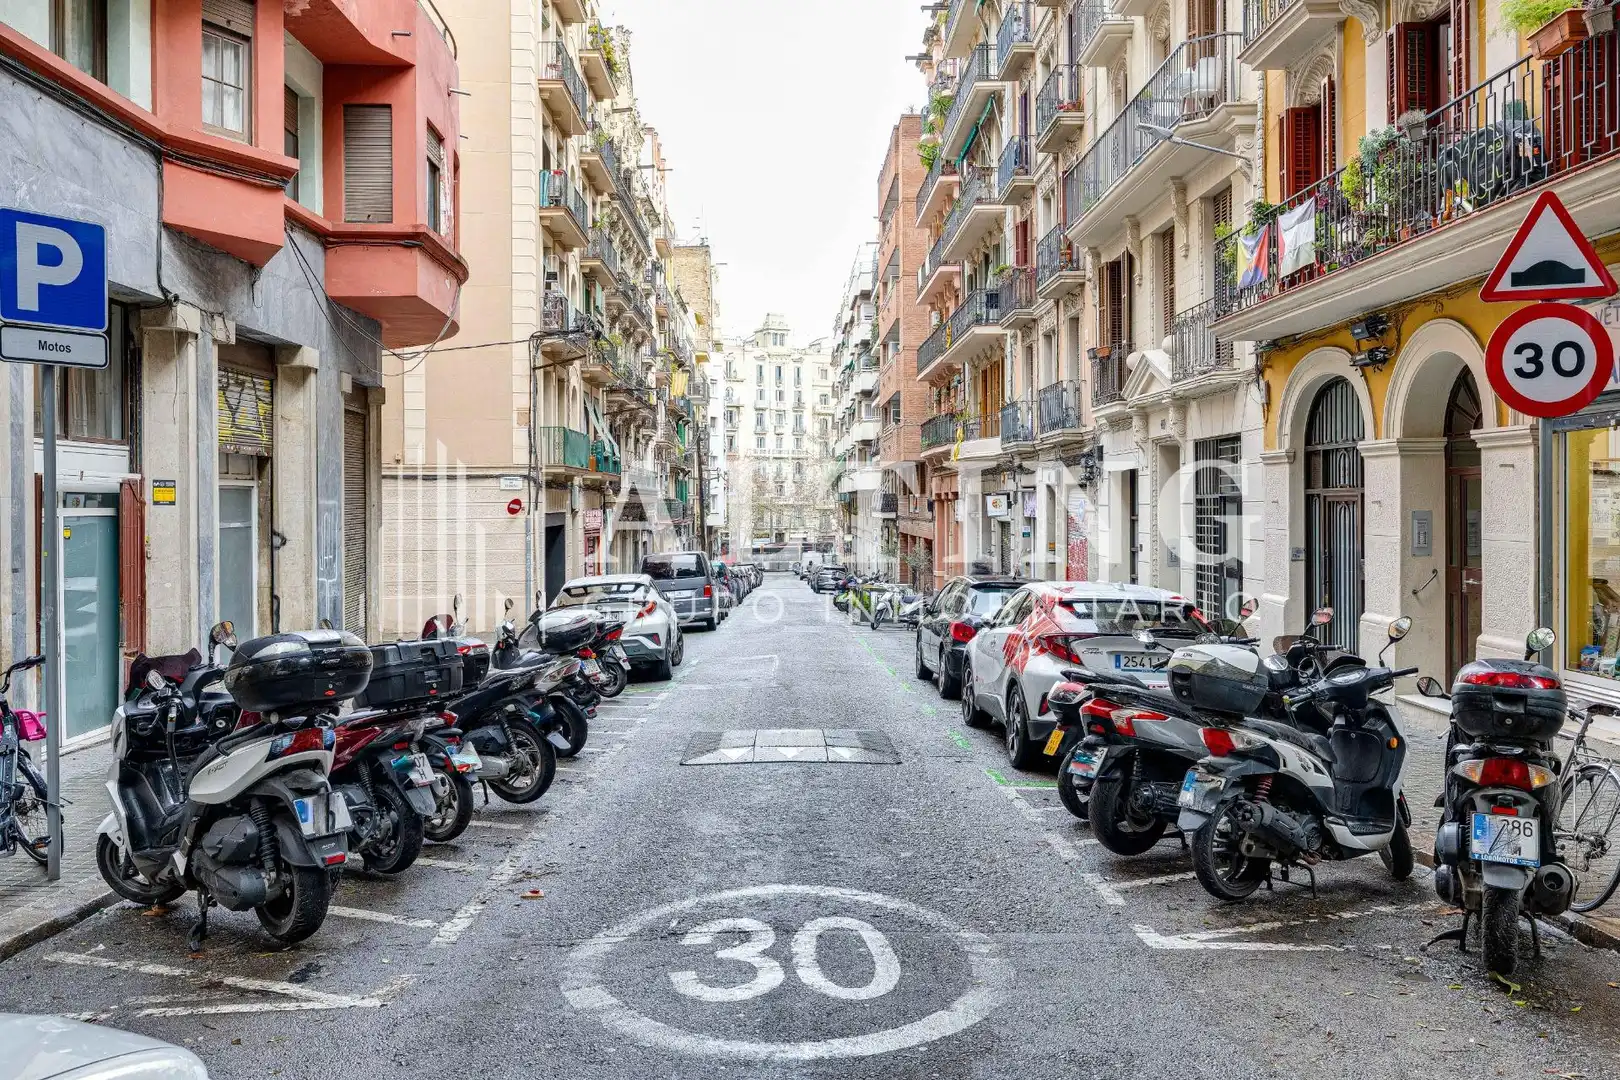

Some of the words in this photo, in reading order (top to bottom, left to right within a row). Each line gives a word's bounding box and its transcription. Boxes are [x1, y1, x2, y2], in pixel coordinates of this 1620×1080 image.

[15, 221, 84, 312] P
[37, 339, 72, 354] Motos
[1512, 341, 1586, 379] 30
[1123, 655, 1153, 669] 2541
[668, 916, 901, 1001] 30
